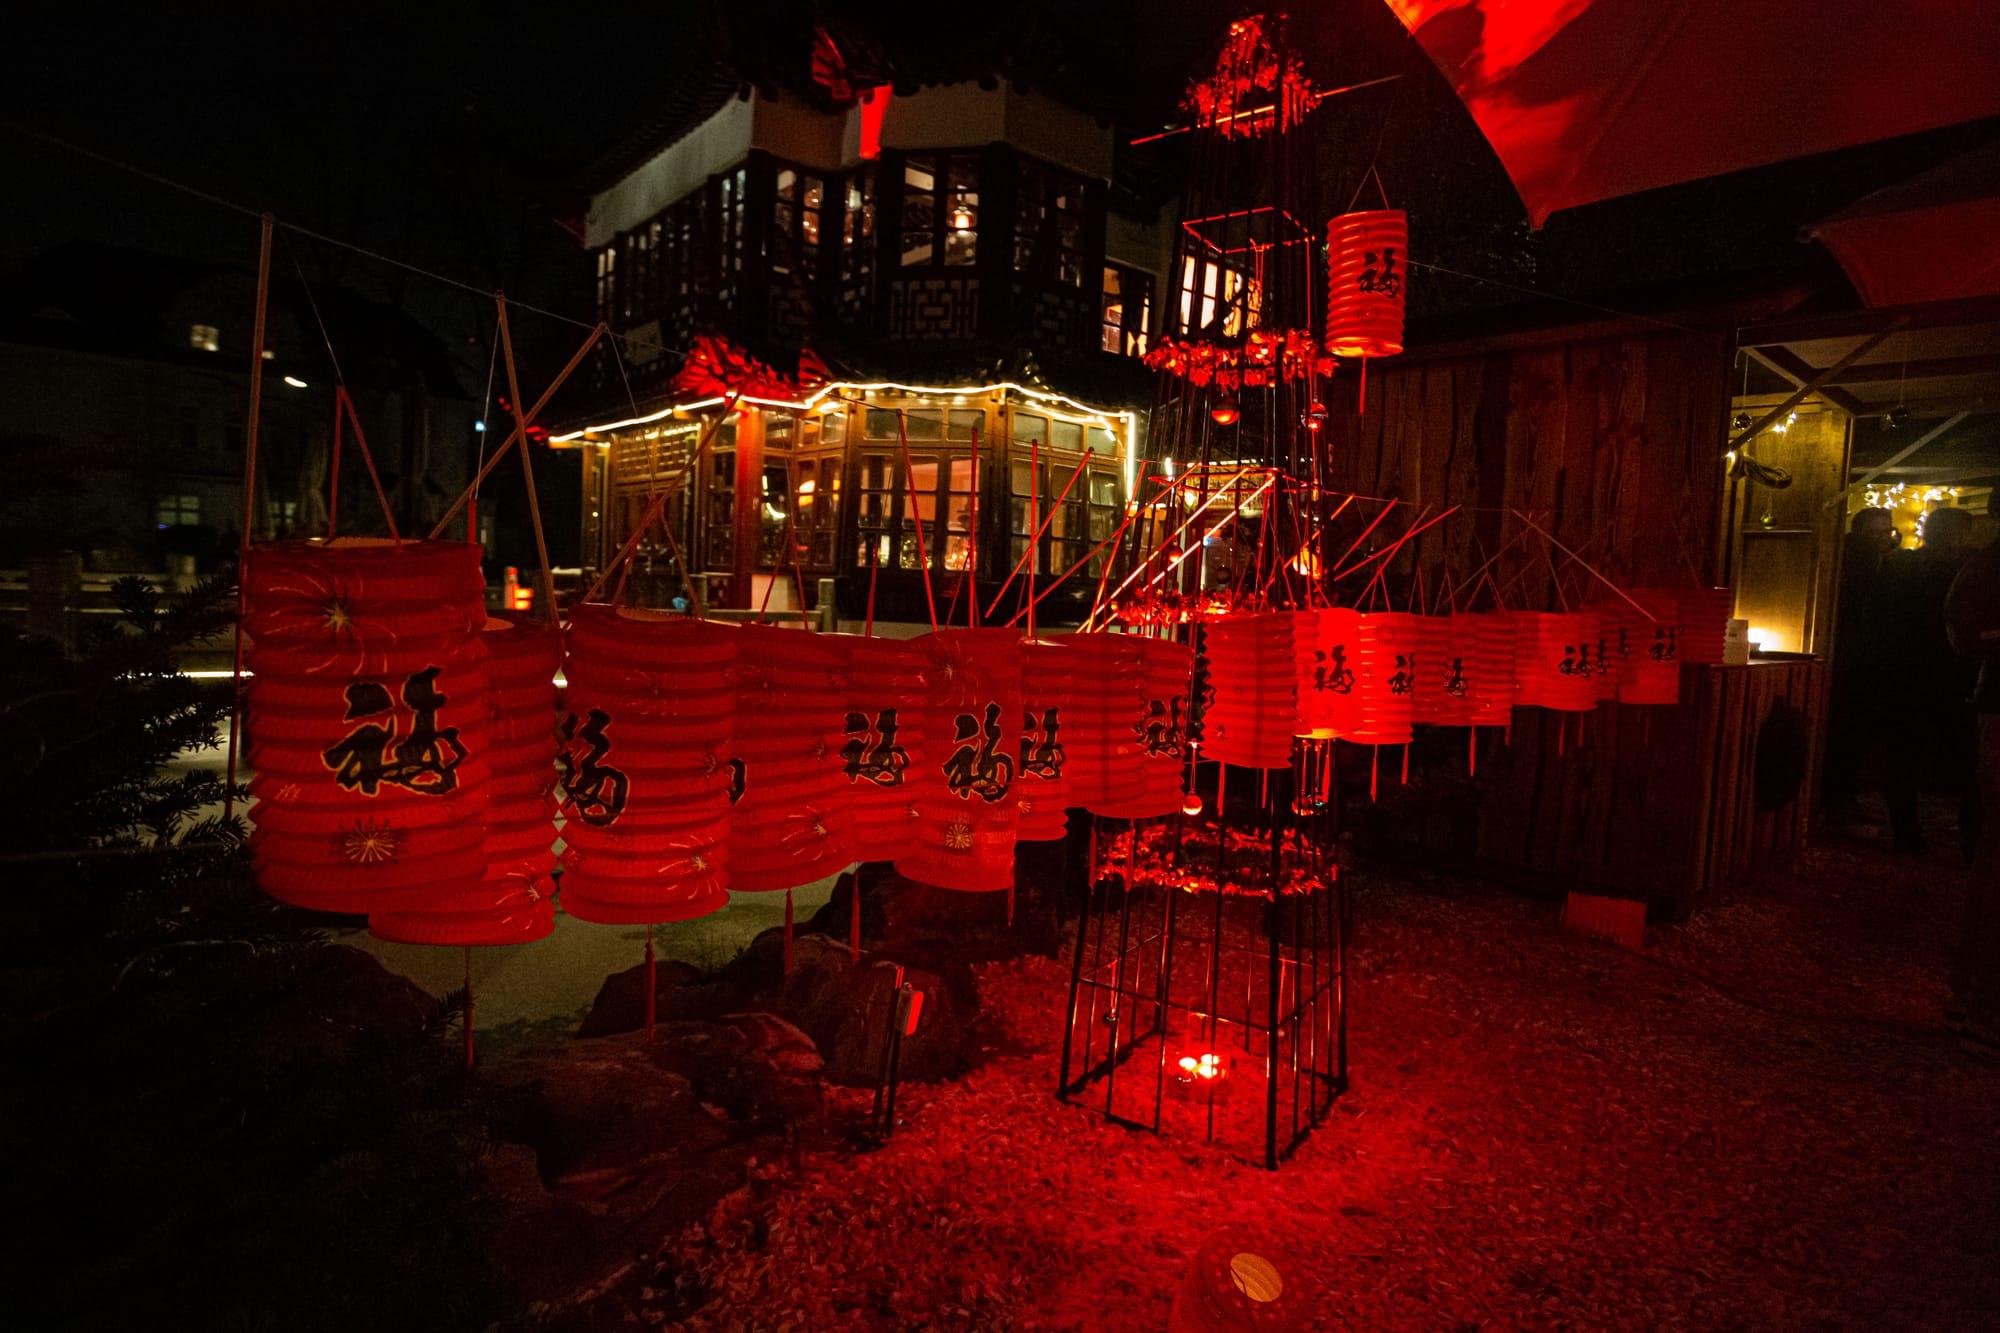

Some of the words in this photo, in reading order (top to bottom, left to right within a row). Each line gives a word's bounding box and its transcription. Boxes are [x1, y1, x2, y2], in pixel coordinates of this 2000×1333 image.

[1357, 248, 1400, 299] 福
[1313, 644, 1356, 694] 福
[1559, 643, 1592, 678] 福
[321, 664, 470, 797] 福
[839, 706, 910, 787] 福
[942, 701, 1014, 802] 福
[1020, 706, 1065, 780] 福
[1131, 694, 1187, 760] 福
